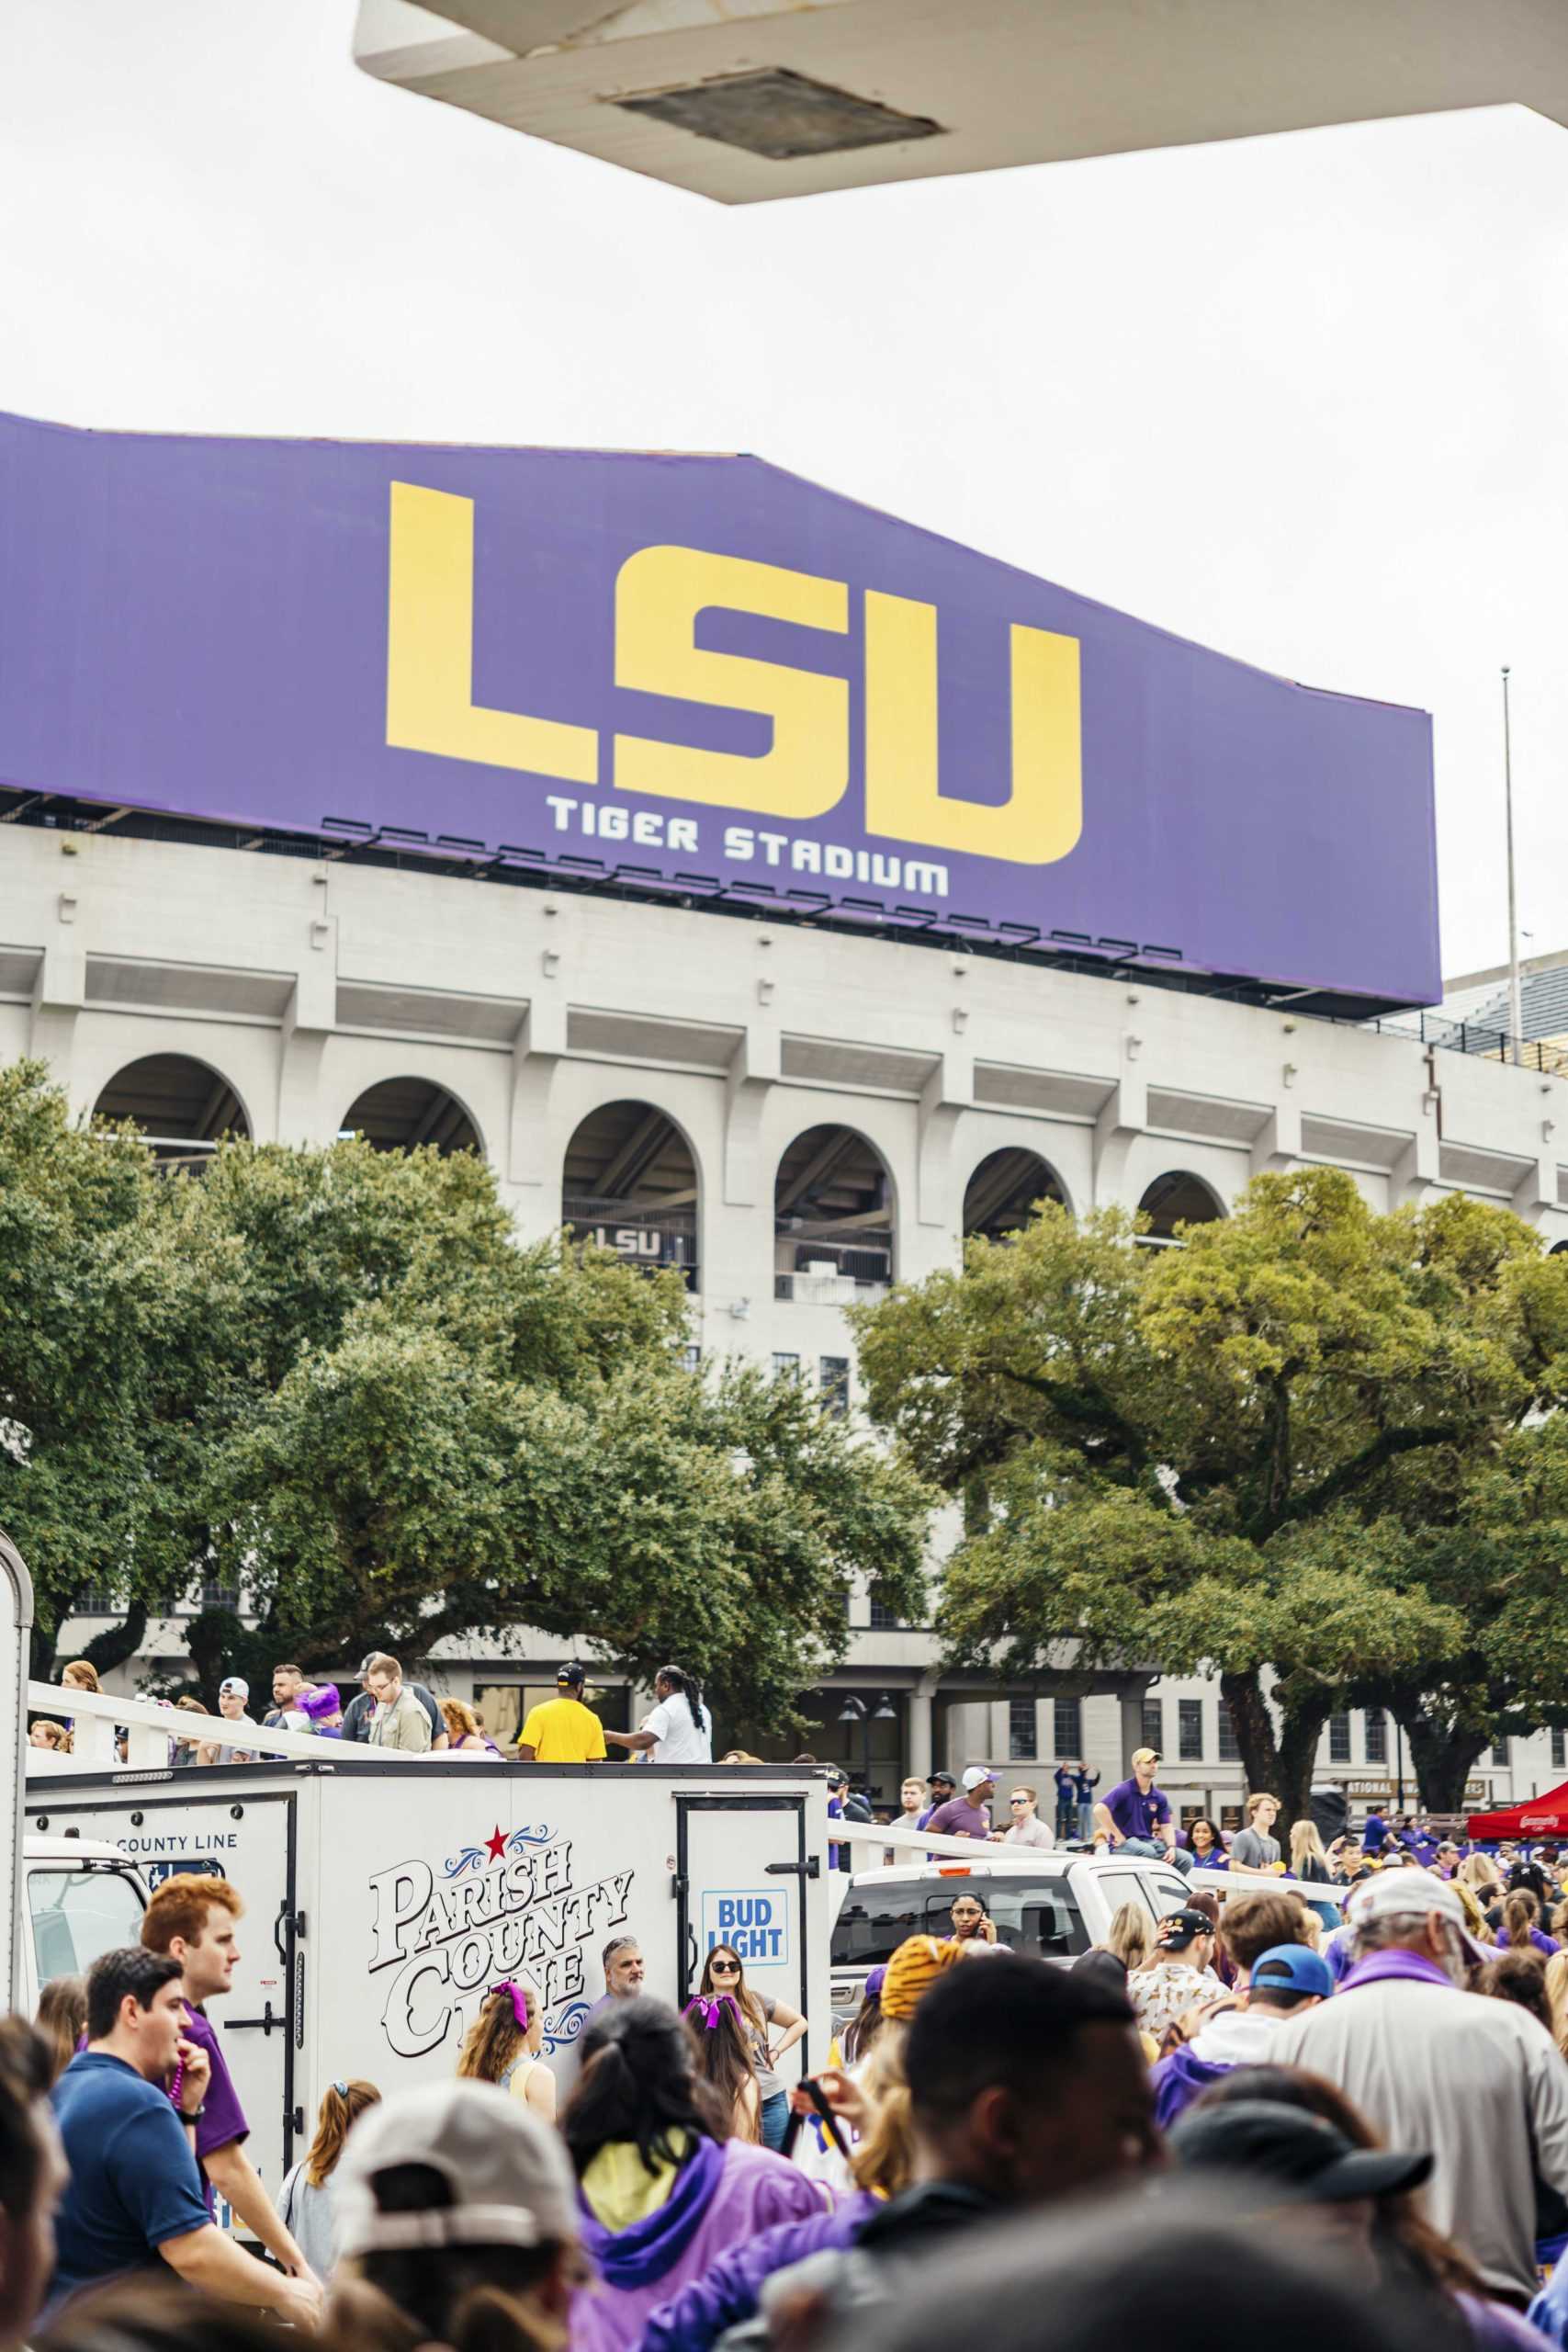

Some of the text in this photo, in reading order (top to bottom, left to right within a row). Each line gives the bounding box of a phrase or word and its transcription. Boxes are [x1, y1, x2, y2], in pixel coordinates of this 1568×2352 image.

[387, 481, 1083, 865] LSU
[546, 795, 949, 897] TIGER STADIUM
[1347, 1781, 1393, 1793] ATIONAL
[195, 1834, 238, 1849] LINE
[367, 1840, 573, 1973] PARISH
[718, 1898, 773, 1928] BUD
[381, 1869, 635, 2058] COUNTY
